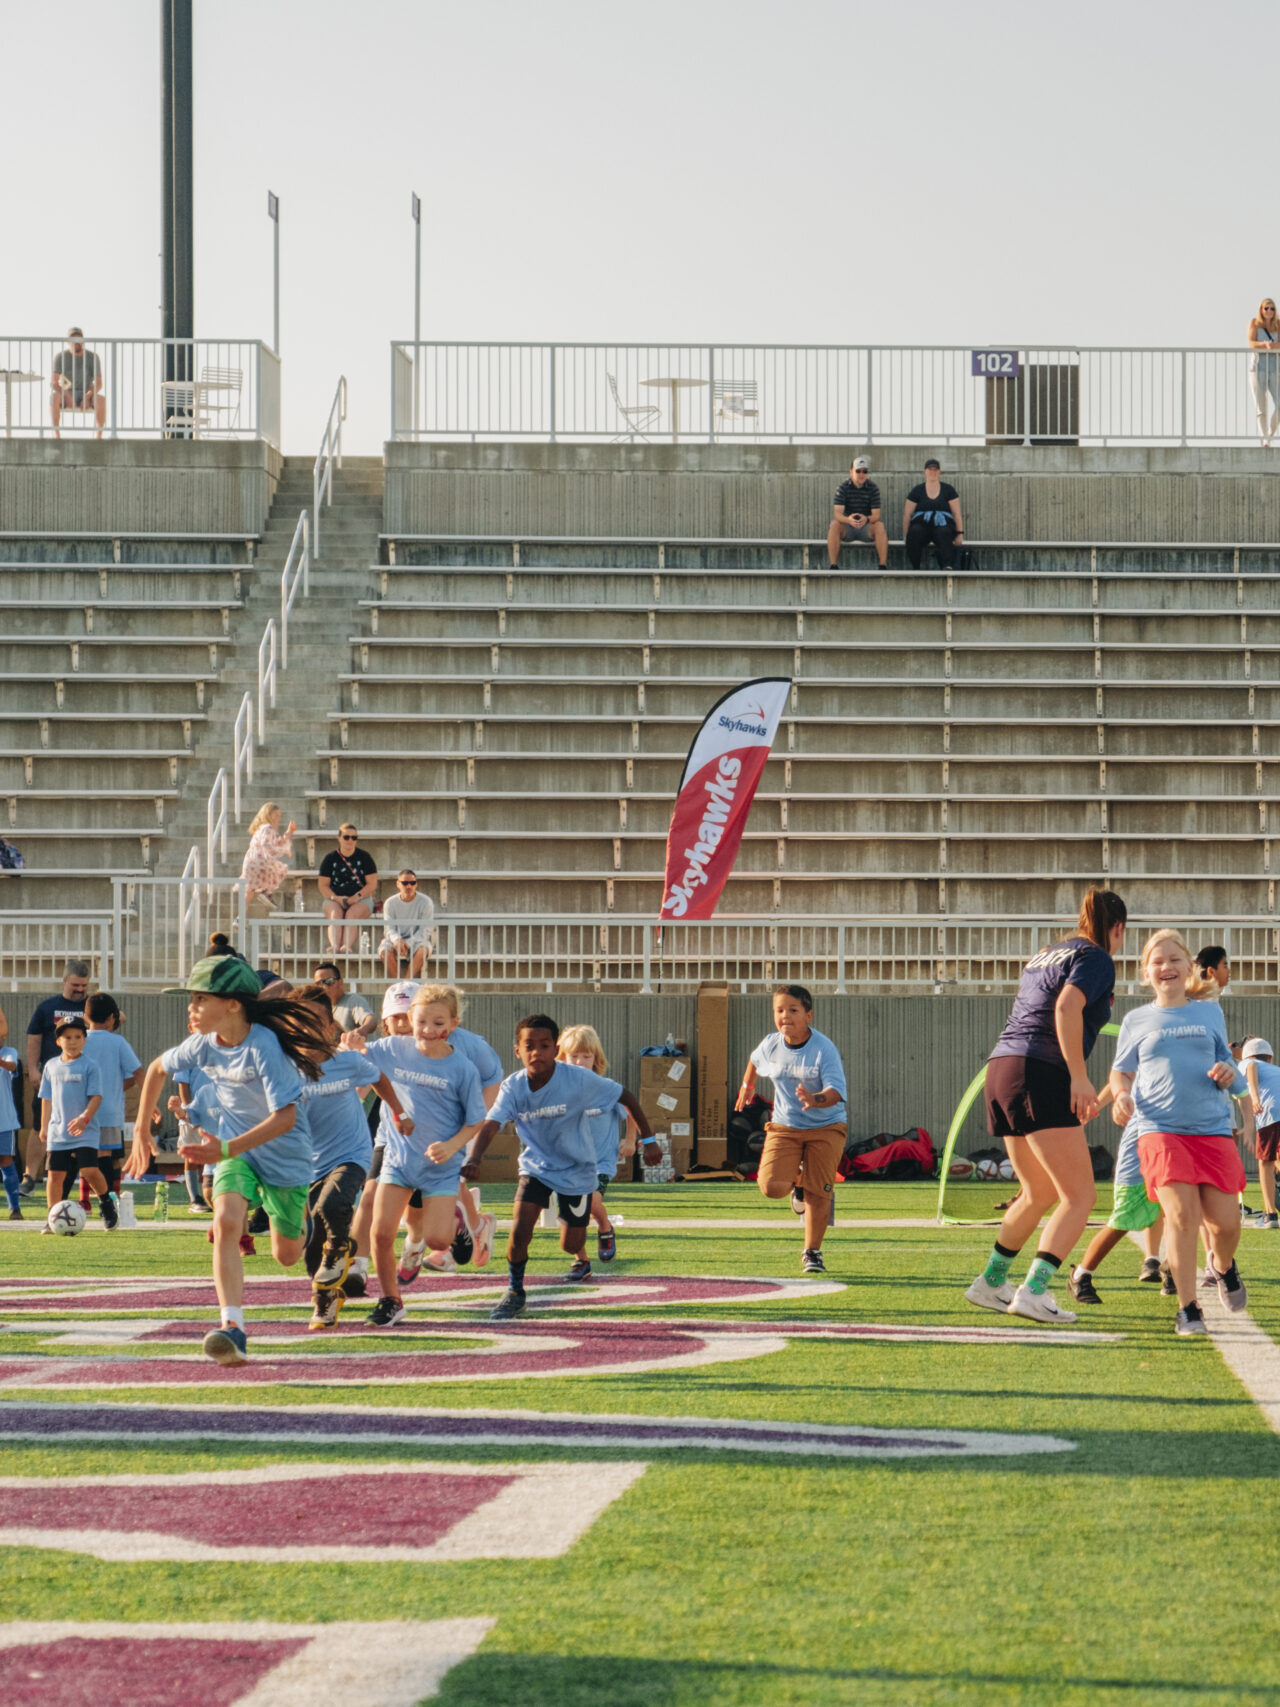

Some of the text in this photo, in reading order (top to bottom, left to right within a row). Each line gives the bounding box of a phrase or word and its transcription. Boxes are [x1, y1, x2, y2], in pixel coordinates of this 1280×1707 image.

[976, 353, 1013, 373] 102
[718, 715, 768, 737] Skyhawks
[662, 755, 742, 918] Skyhawks
[394, 1067, 449, 1089] SKYHAWKS
